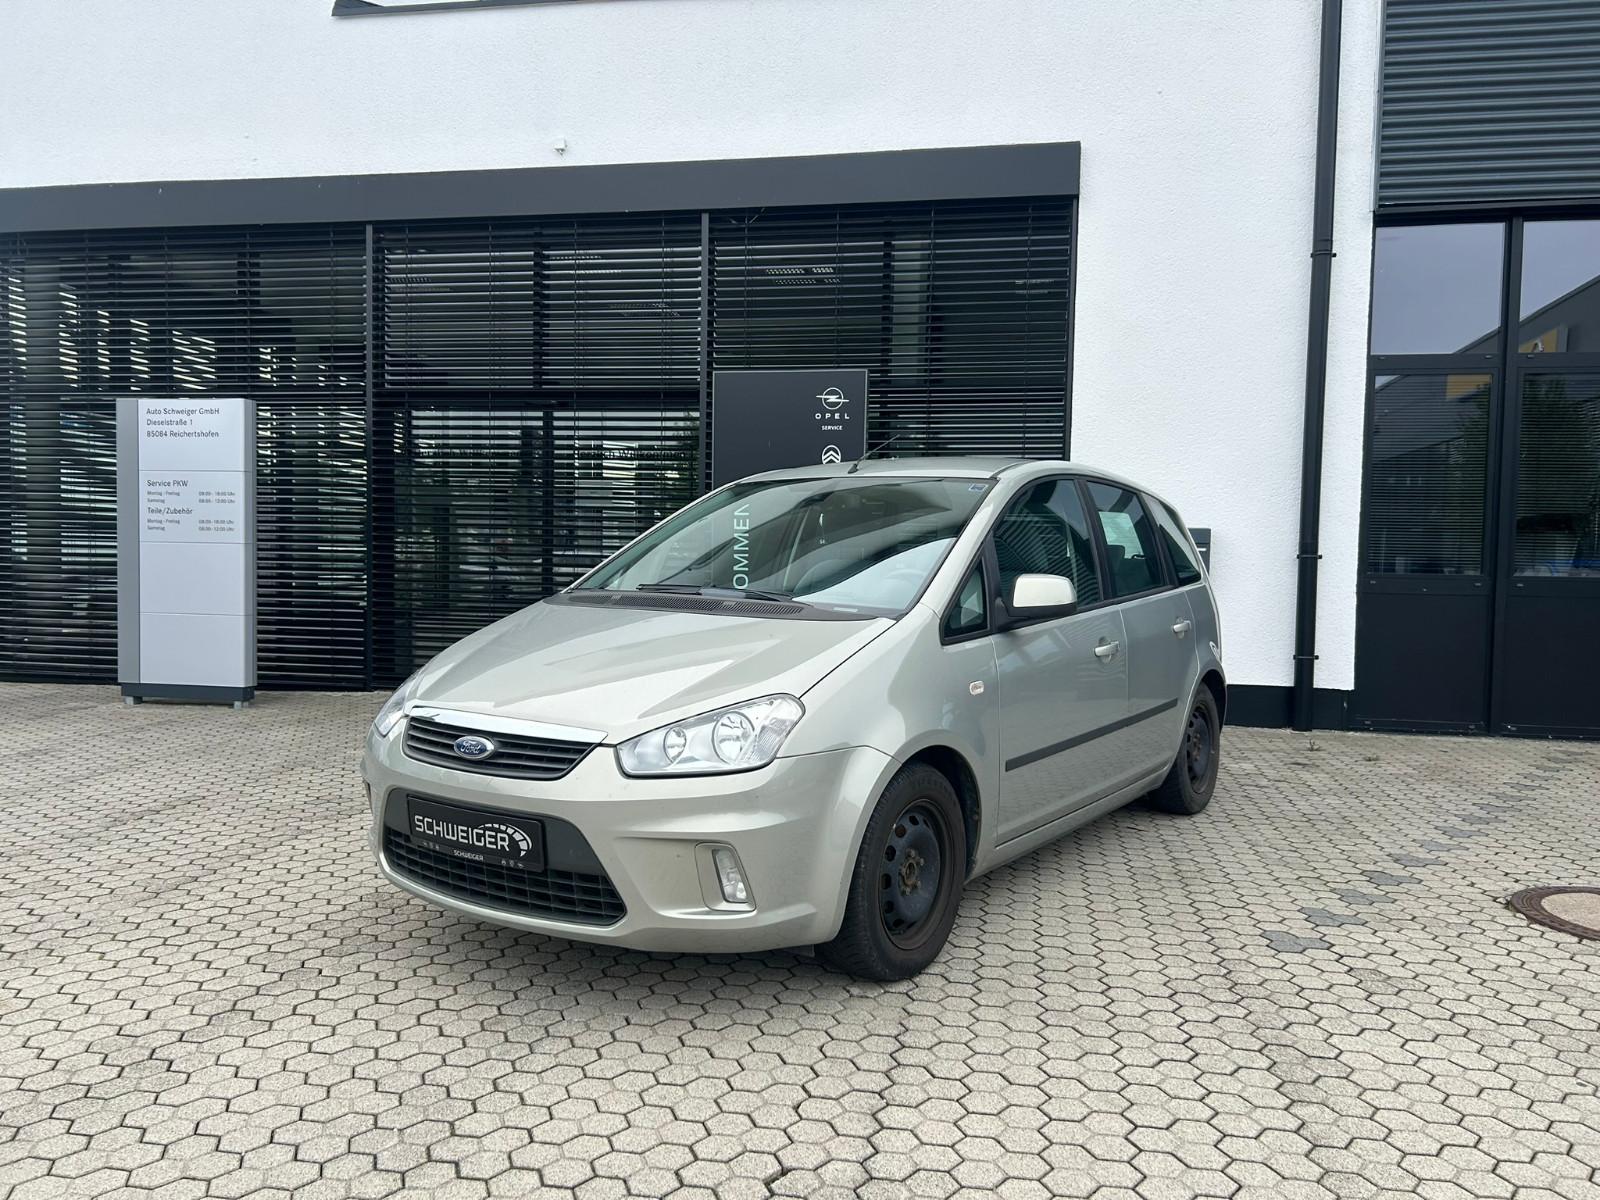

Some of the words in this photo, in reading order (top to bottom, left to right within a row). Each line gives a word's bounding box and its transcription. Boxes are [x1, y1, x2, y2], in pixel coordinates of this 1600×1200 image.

[163, 408, 197, 416] Schweiger
[146, 430, 168, 438] 85084
[169, 430, 219, 438] Reichertshofen
[147, 507, 193, 515] Teile/Zubehör
[414, 815, 510, 852] SCHWEIGER
[453, 849, 484, 861] SCHWEIGER
